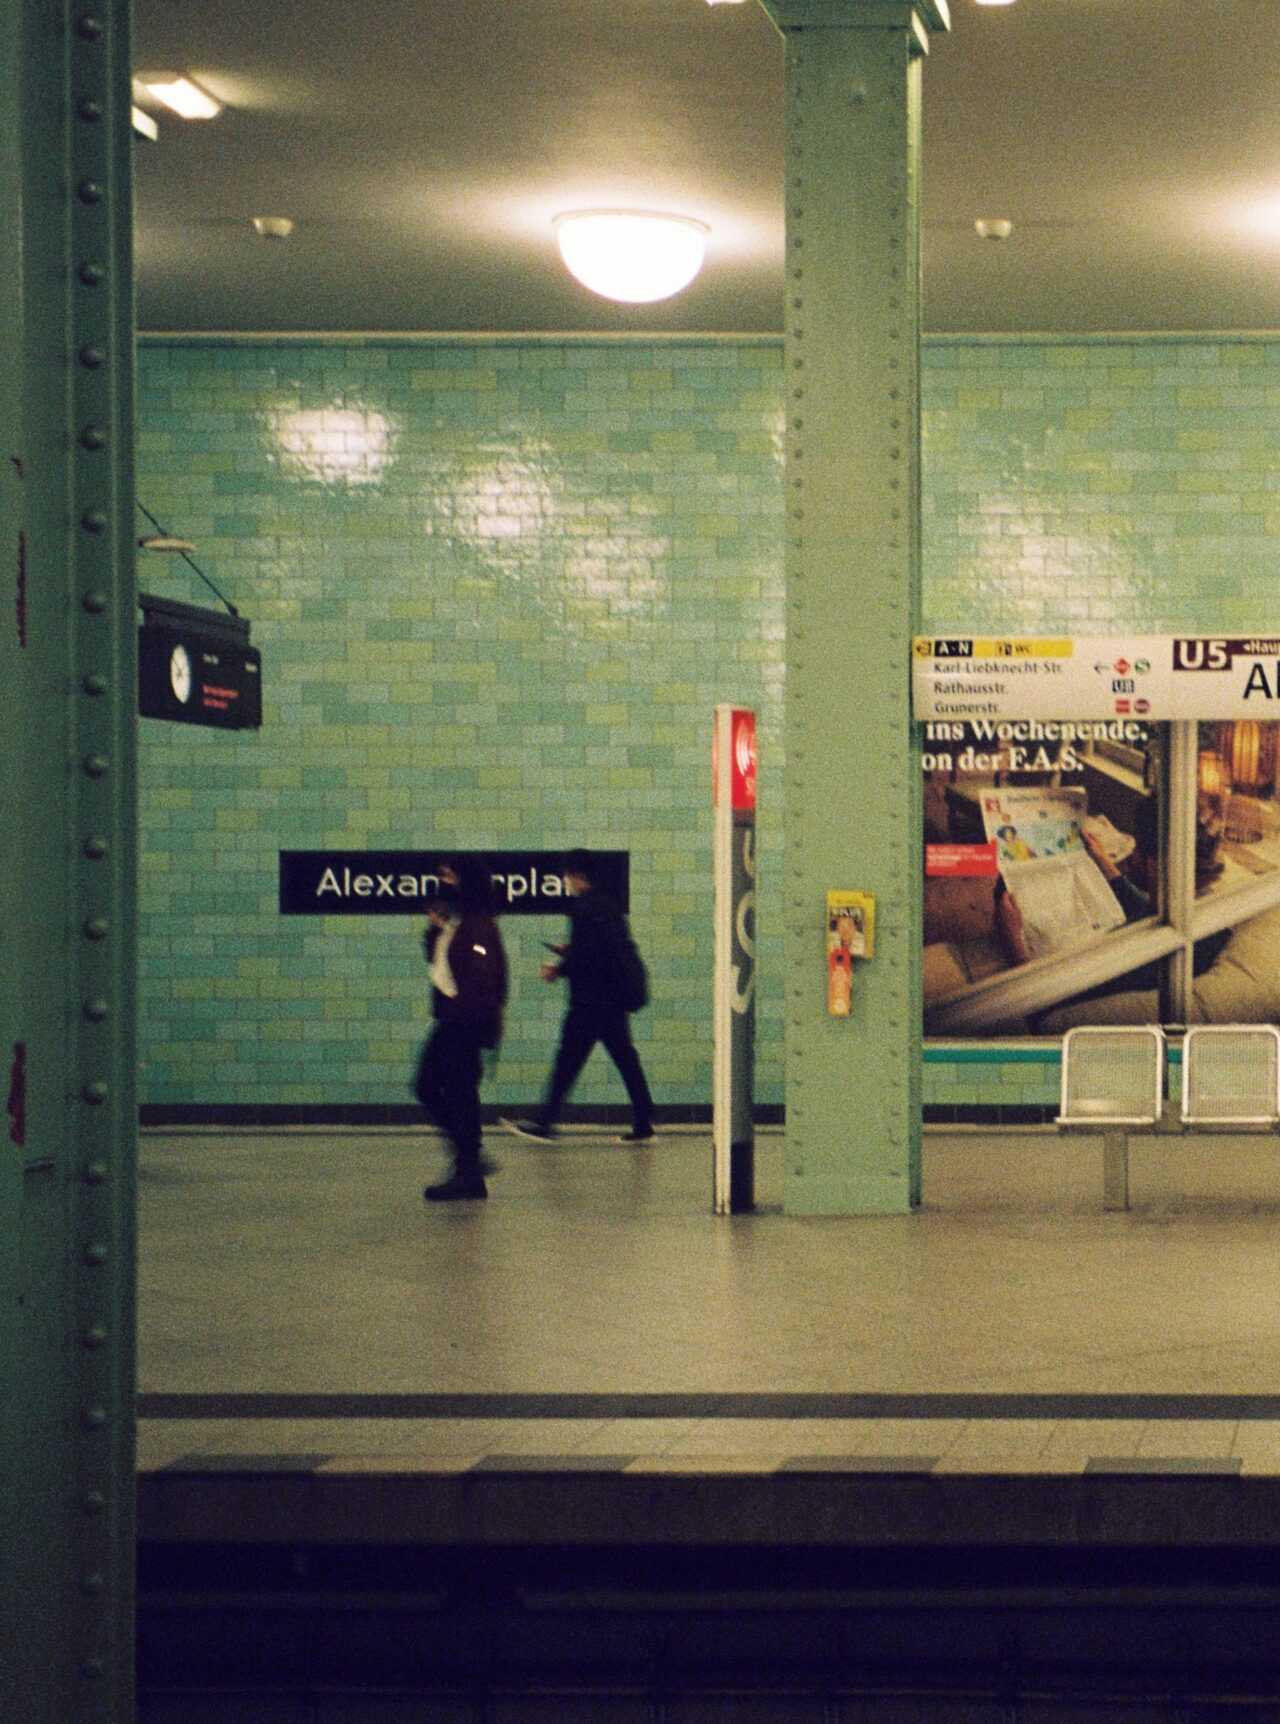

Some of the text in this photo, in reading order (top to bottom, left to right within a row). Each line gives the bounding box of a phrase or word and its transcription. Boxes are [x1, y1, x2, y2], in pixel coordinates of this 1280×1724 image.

[1179, 640, 1228, 670] U5
[970, 720, 1148, 741] Wochenende.
[921, 752, 953, 772] on
[958, 746, 1002, 772] der
[315, 866, 577, 903] Alexanrpla
